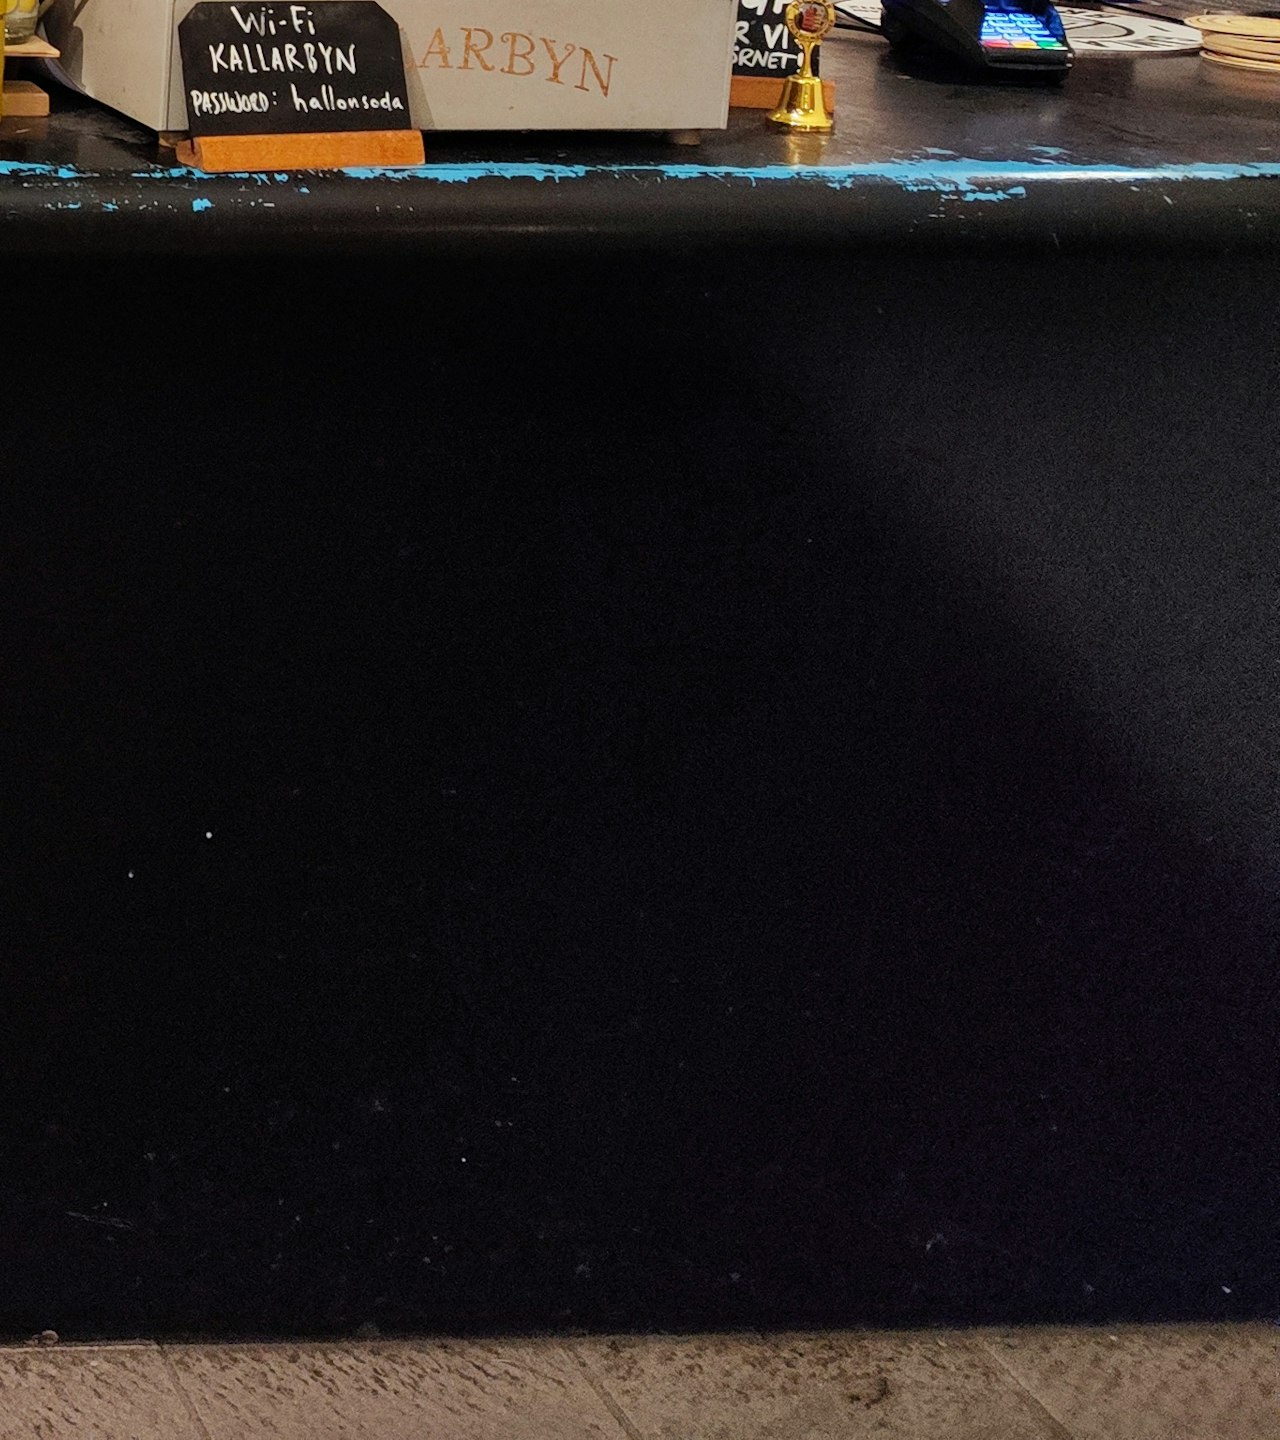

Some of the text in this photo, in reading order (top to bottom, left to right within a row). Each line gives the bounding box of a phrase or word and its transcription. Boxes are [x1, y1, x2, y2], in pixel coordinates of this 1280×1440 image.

[232, 7, 316, 36] Wi-Fi
[209, 43, 357, 75] KALLARBYN
[291, 81, 405, 113] hallonsoda
